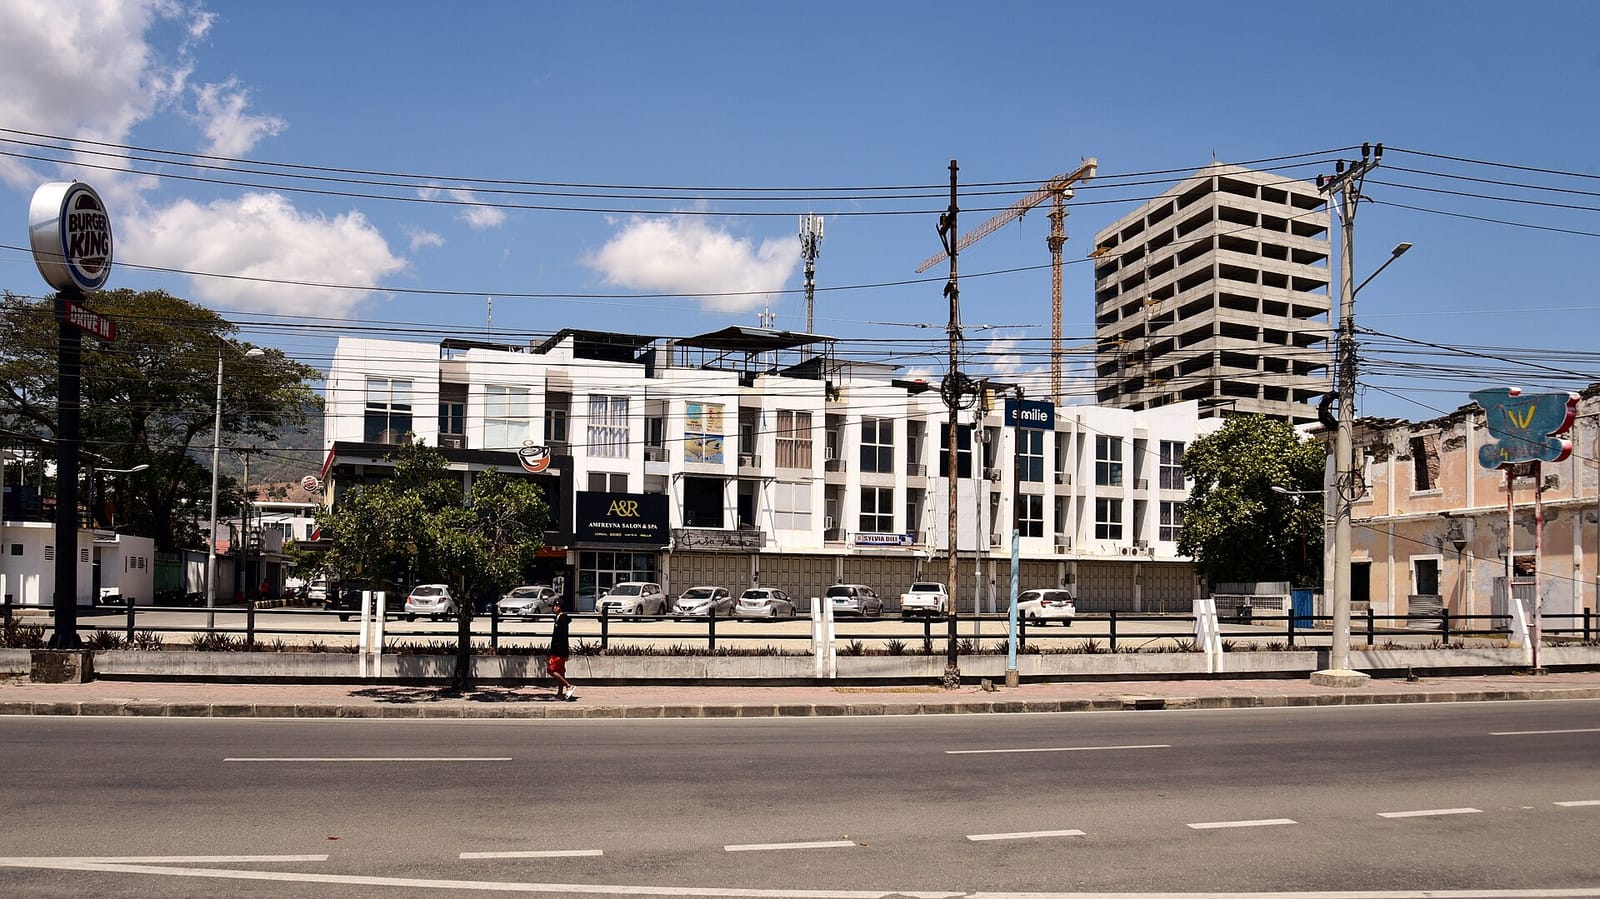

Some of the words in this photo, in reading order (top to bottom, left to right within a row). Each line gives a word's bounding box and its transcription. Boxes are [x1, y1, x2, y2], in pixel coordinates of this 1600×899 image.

[69, 213, 107, 233] BURGER
[70, 234, 109, 257] KING
[70, 305, 98, 332] DRIVE
[100, 319, 110, 337] IN
[606, 499, 641, 517] A&R
